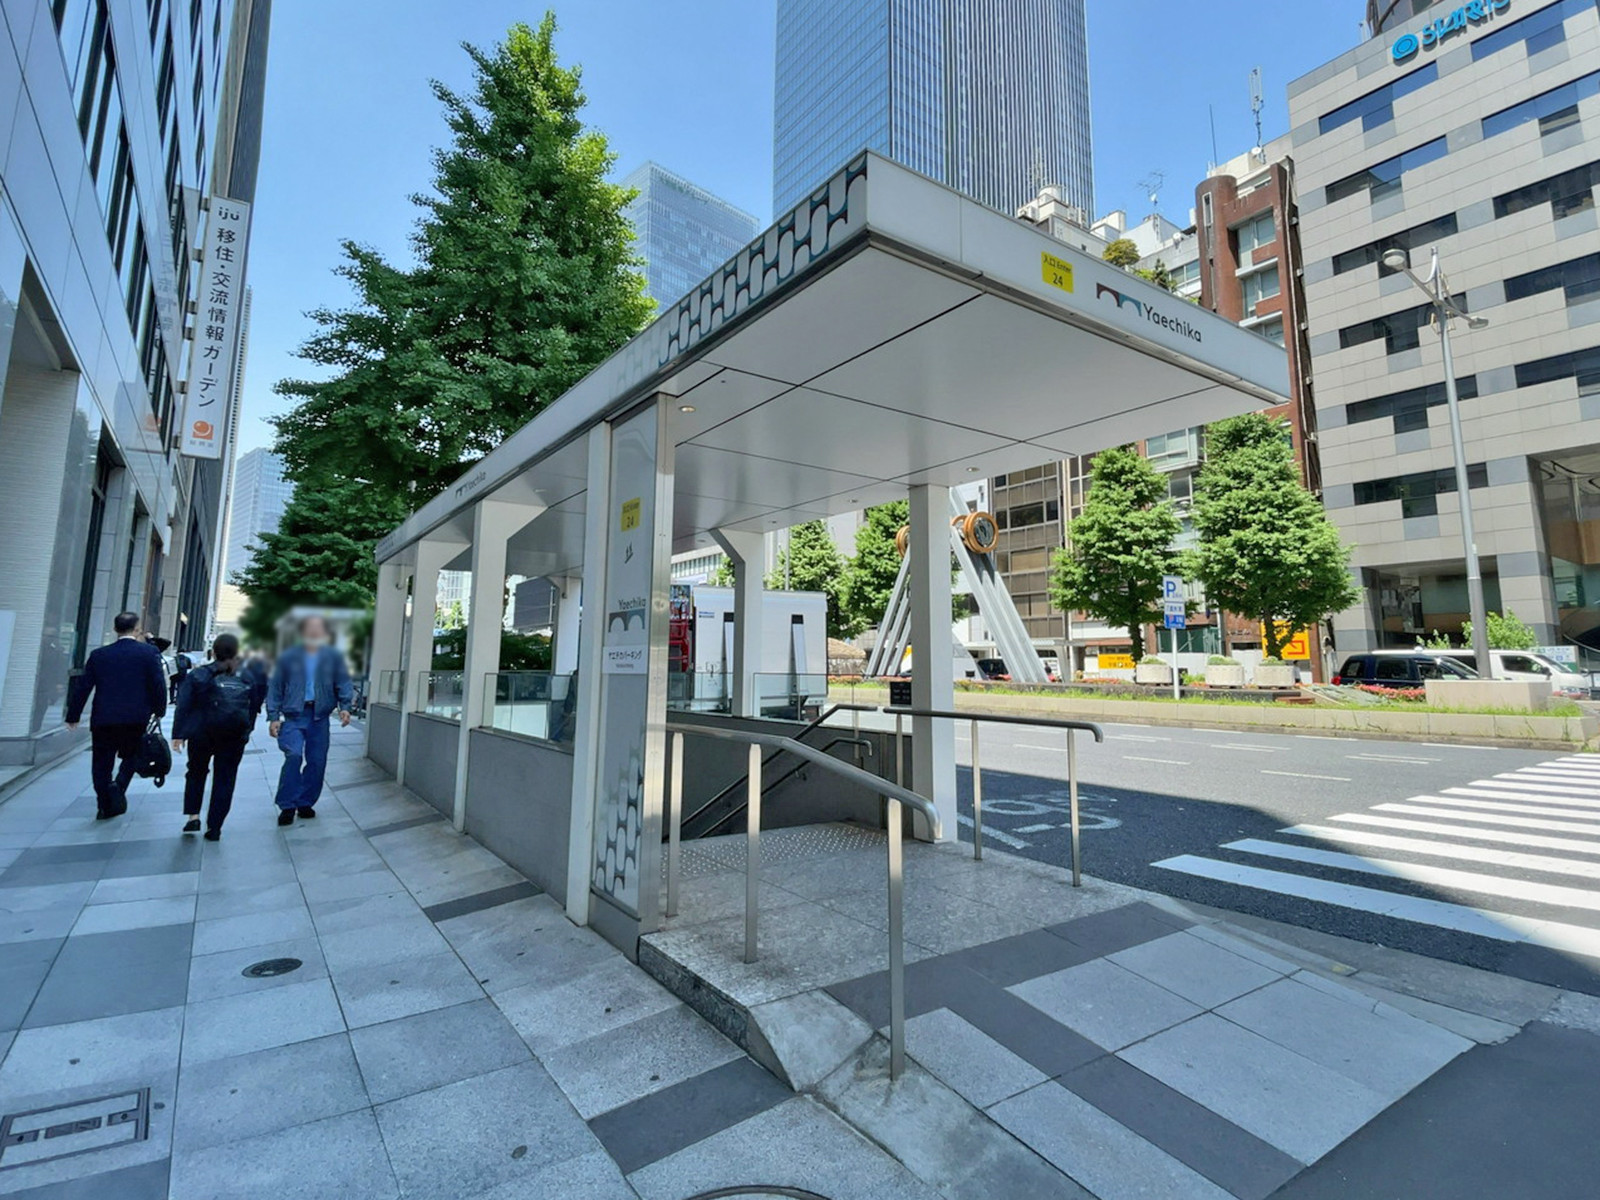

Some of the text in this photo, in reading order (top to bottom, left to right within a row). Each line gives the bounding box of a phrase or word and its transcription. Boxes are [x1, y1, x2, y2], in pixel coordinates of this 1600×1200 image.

[1043, 254, 1072, 272] 入口 Enter
[1052, 272, 1063, 286] 24
[197, 227, 237, 409] 移住・交流情報ガーデン
[1143, 303, 1202, 343] Yaechika
[1166, 580, 1176, 598] P
[618, 597, 647, 610] Yaechika
